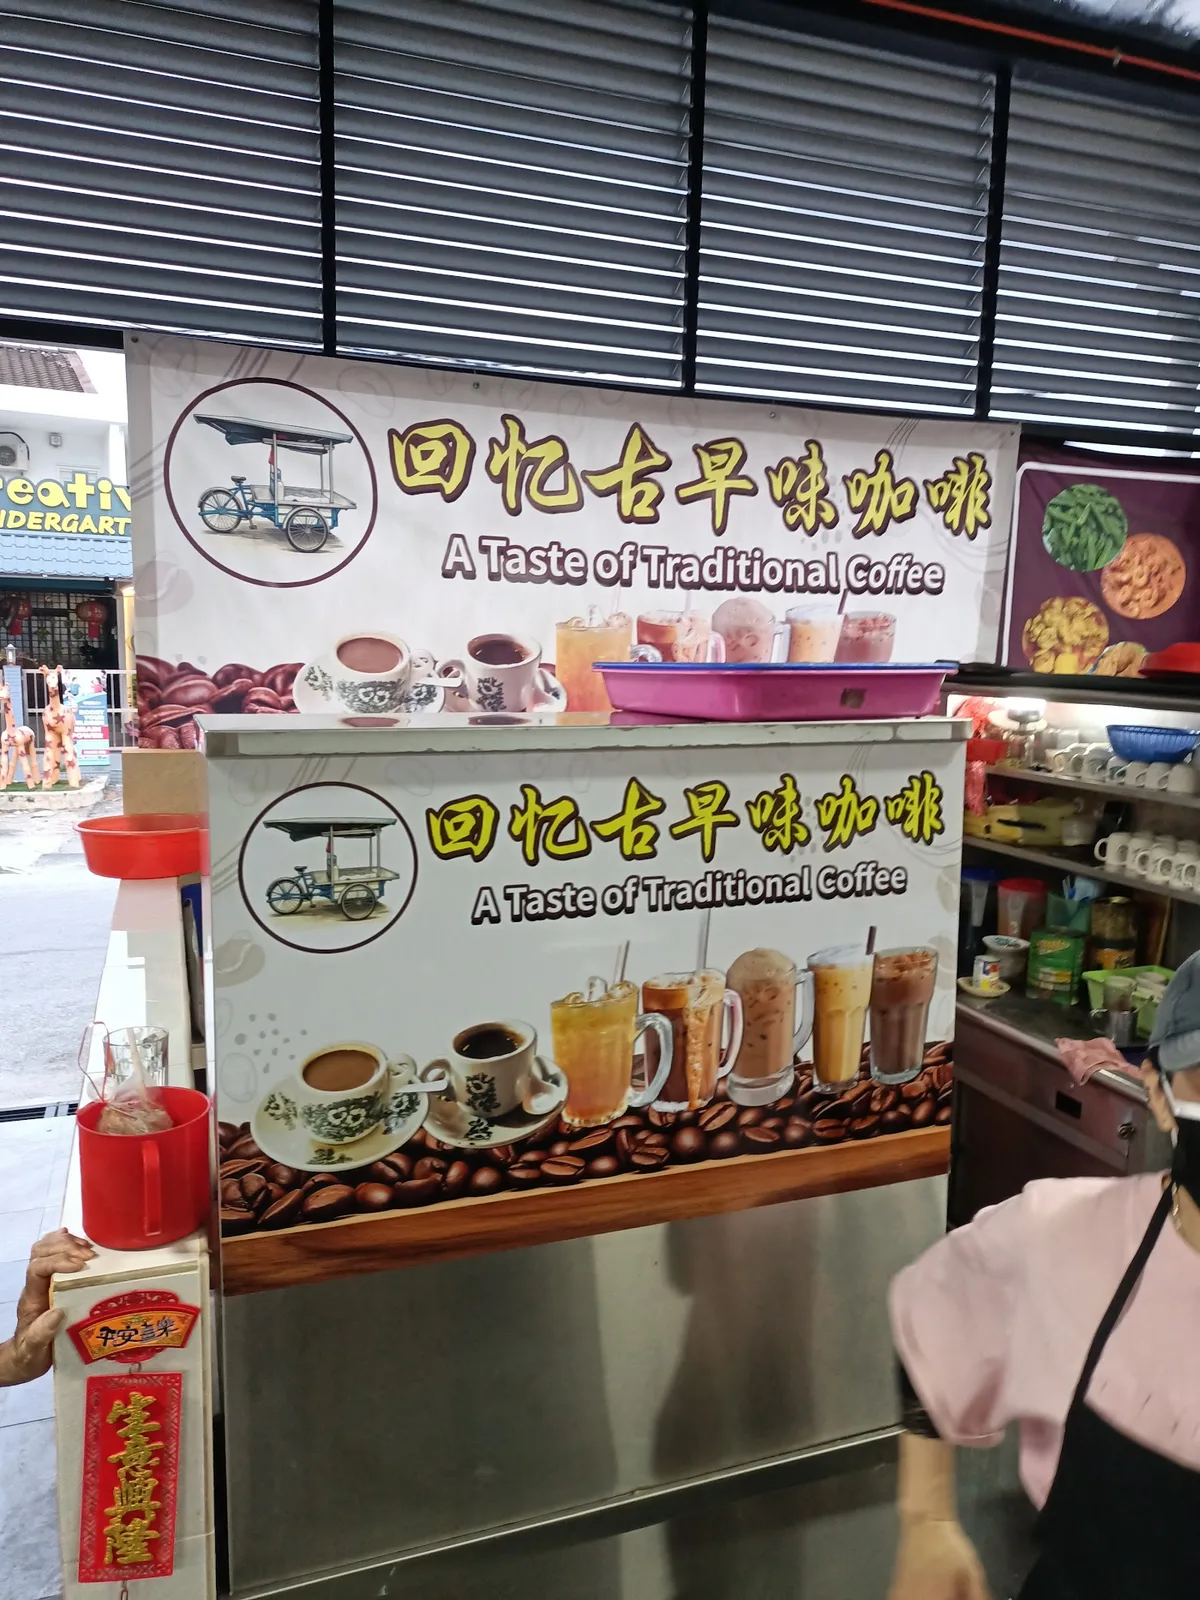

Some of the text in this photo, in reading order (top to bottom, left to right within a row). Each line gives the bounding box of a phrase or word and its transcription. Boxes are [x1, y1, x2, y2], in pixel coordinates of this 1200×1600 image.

[387, 413, 992, 541] 回忆古早味咖啡
[442, 534, 946, 596] A Taste of Traditional Coffee
[425, 770, 945, 867] 回忆古早味咖啡
[471, 861, 908, 925] A Taste of Traditional Coffee
